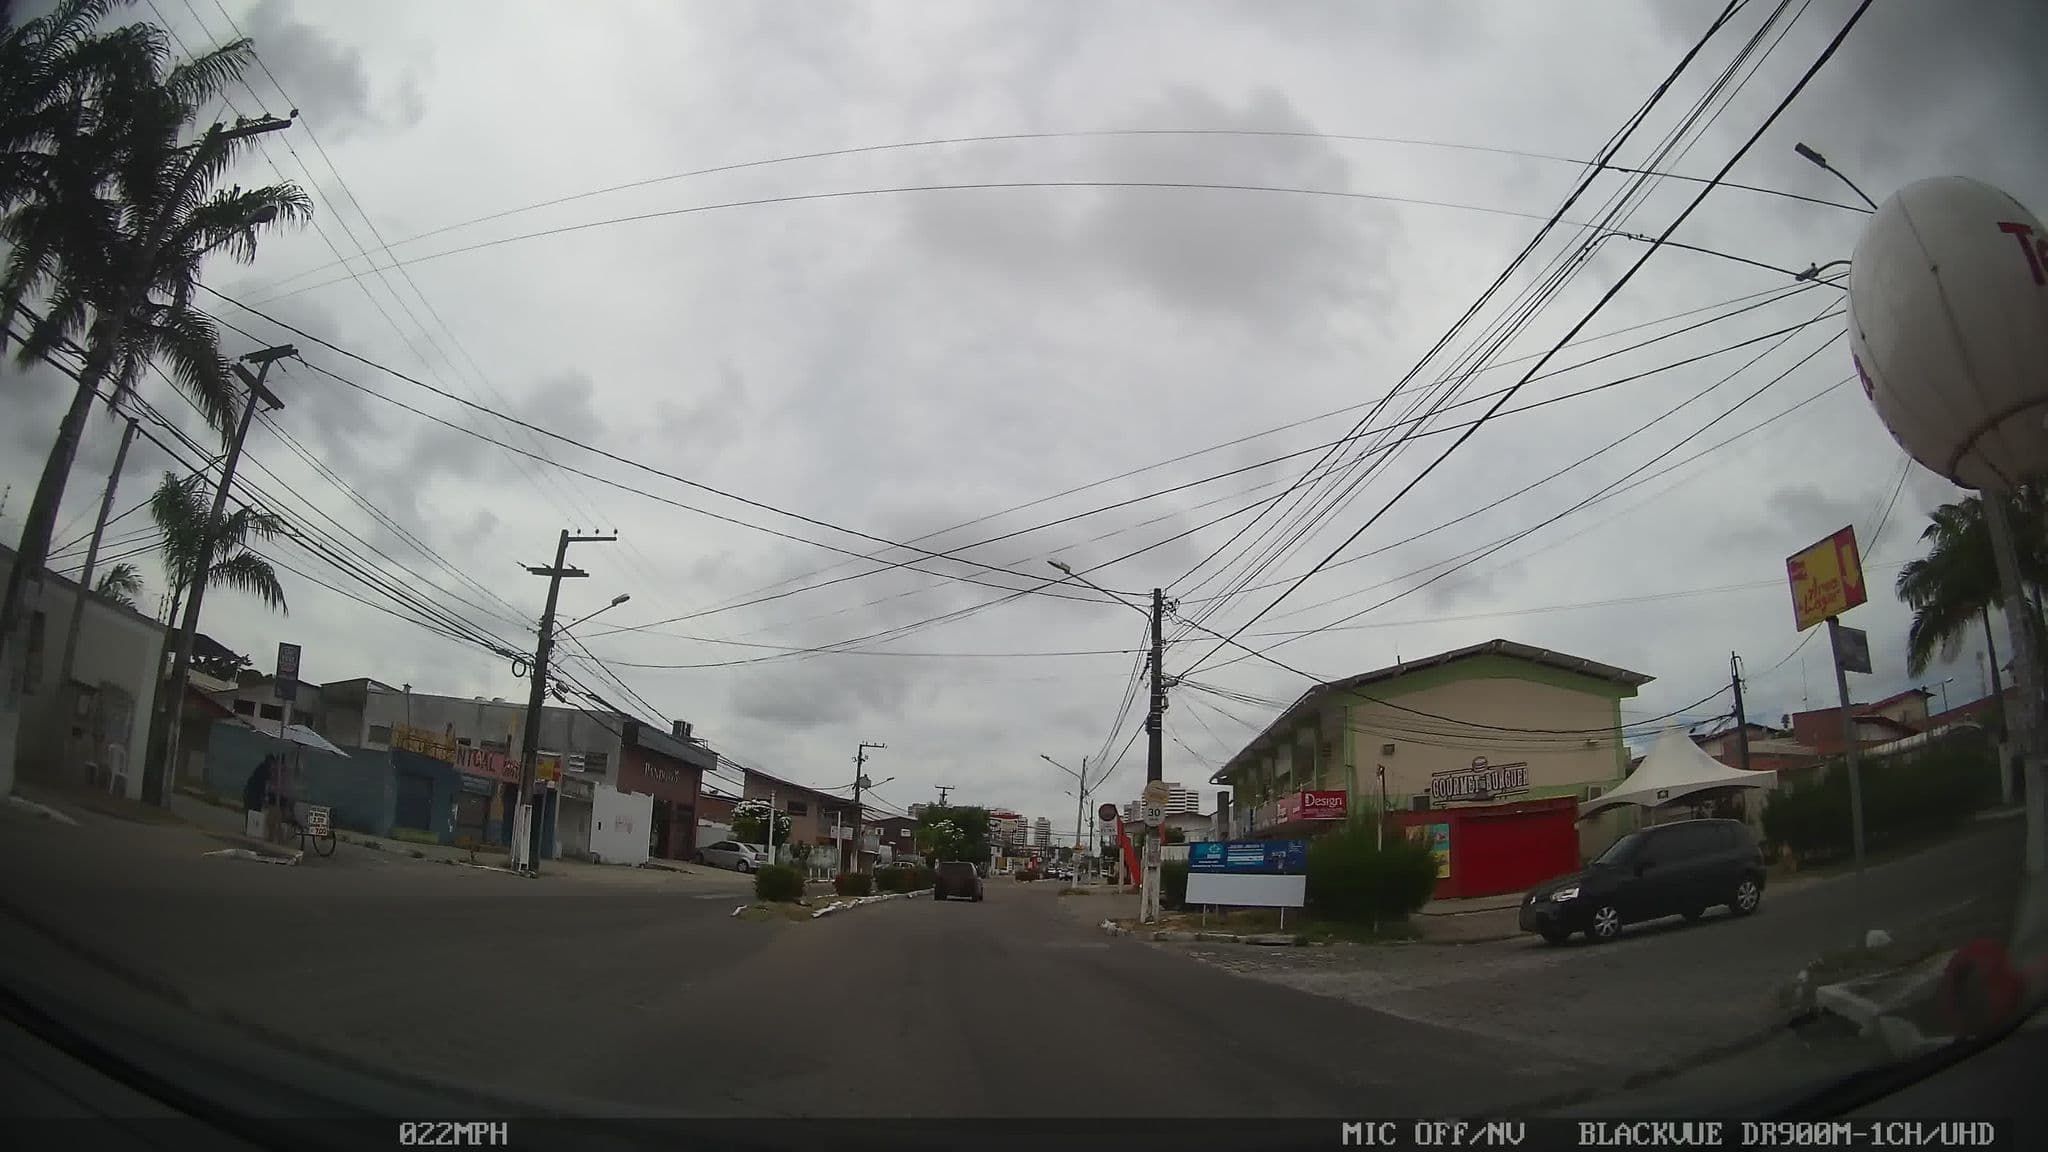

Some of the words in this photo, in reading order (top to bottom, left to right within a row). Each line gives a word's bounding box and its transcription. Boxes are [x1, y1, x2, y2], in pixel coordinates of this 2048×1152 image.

[1432, 774, 1480, 798] GOURMET
[1305, 793, 1343, 808] Design
[1148, 808, 1161, 817] 30
